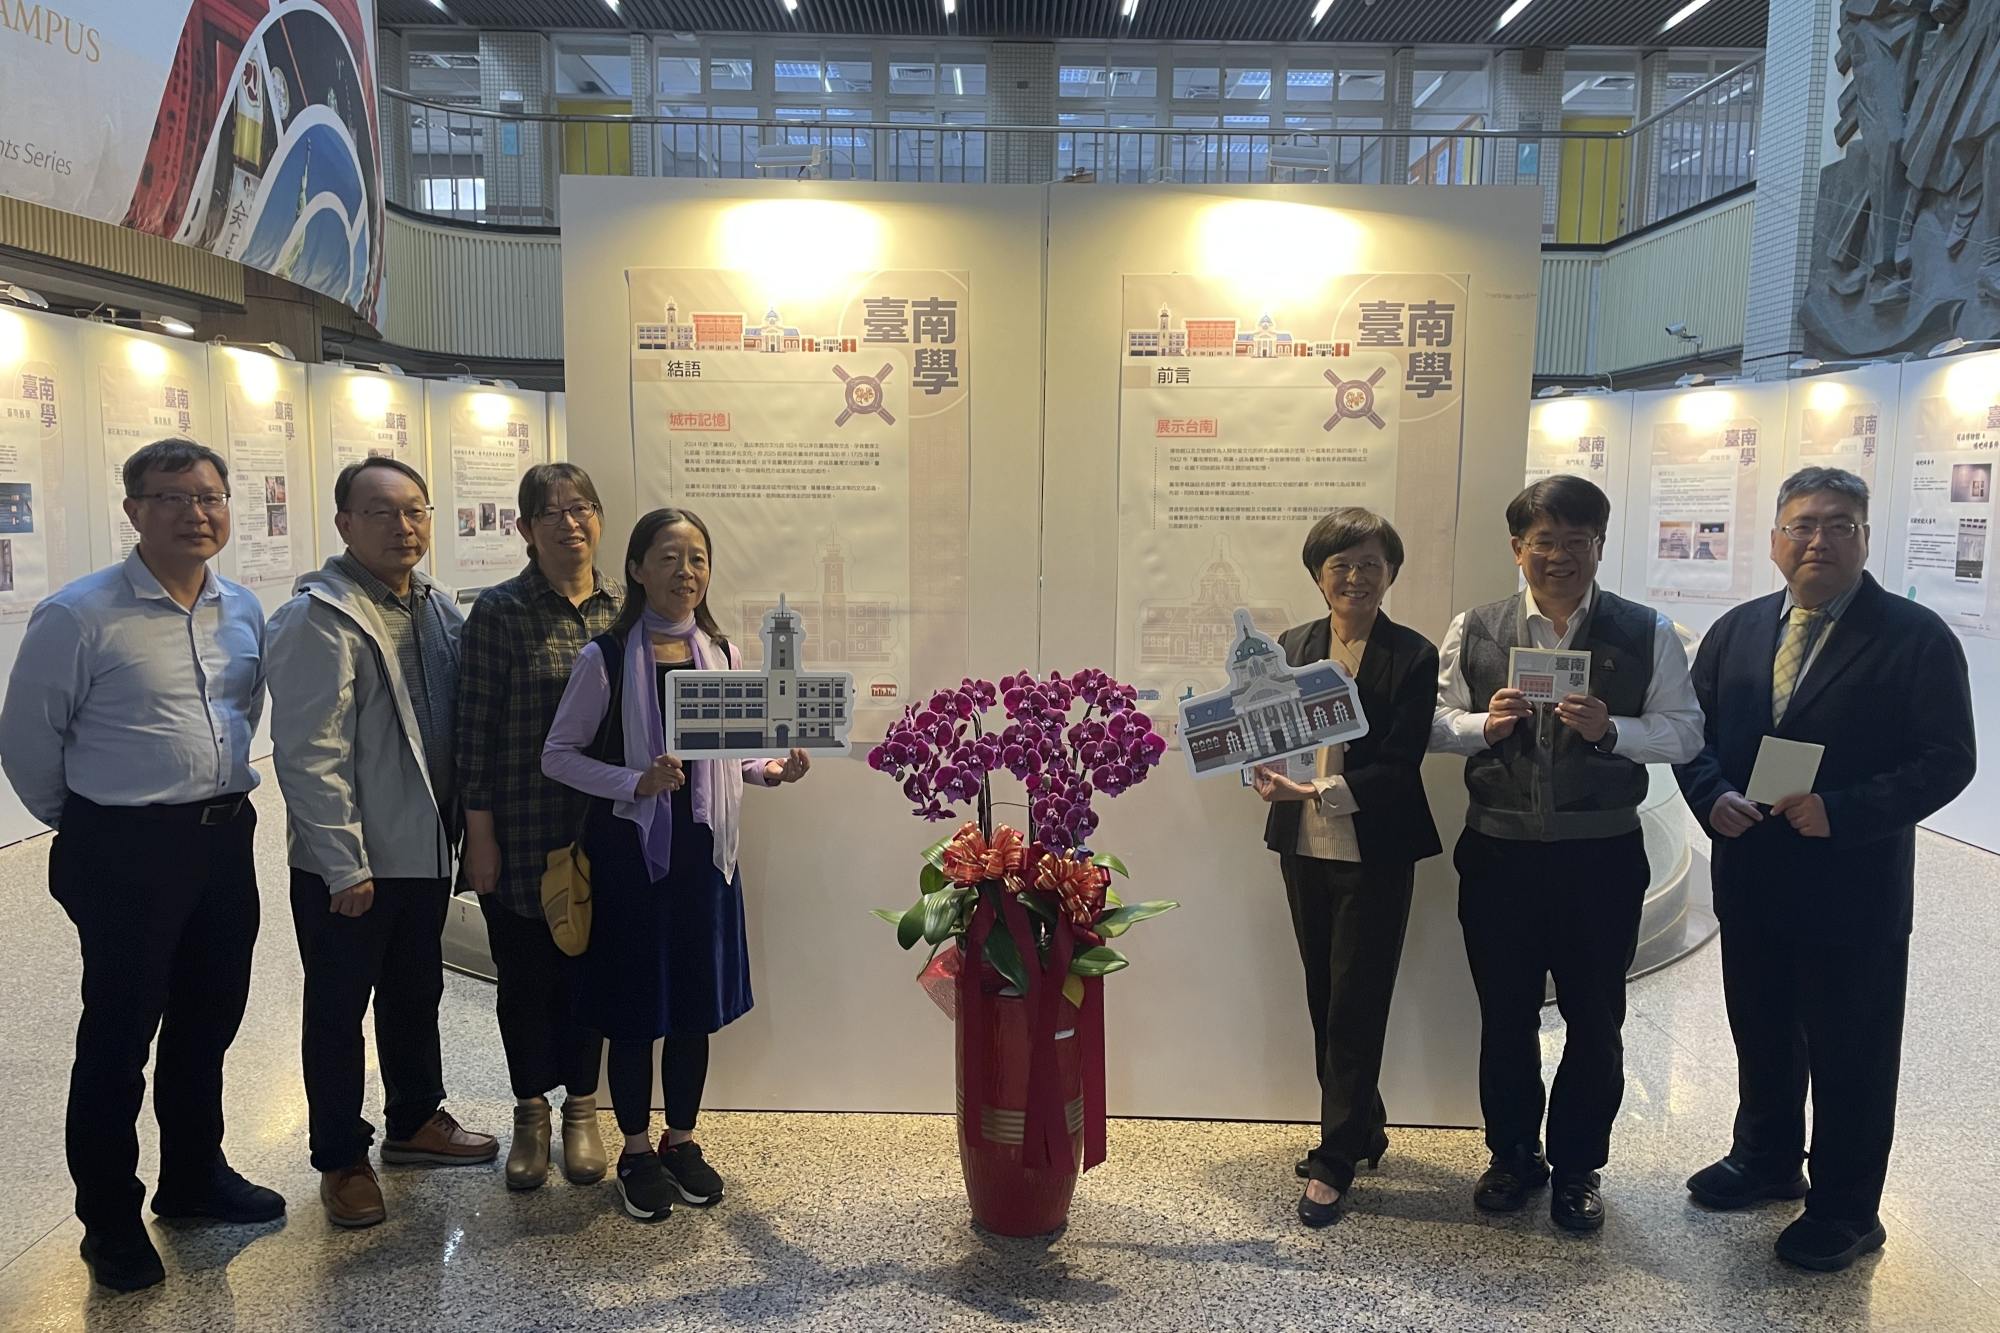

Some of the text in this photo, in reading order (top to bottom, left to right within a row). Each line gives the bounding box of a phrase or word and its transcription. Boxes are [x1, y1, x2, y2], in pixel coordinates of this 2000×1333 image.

[23, 142, 73, 176] Series
[863, 296, 957, 344] 臺南
[1356, 300, 1455, 347] 臺南
[667, 360, 701, 378] 結語
[912, 348, 959, 395] 學
[1157, 367, 1191, 384] 前言
[1405, 352, 1453, 399] 學
[22, 374, 55, 402] 臺南
[165, 387, 189, 410] 臺南
[40, 403, 57, 429] 學
[670, 412, 726, 427] 城市記憶
[1157, 419, 1213, 434] 展示台南
